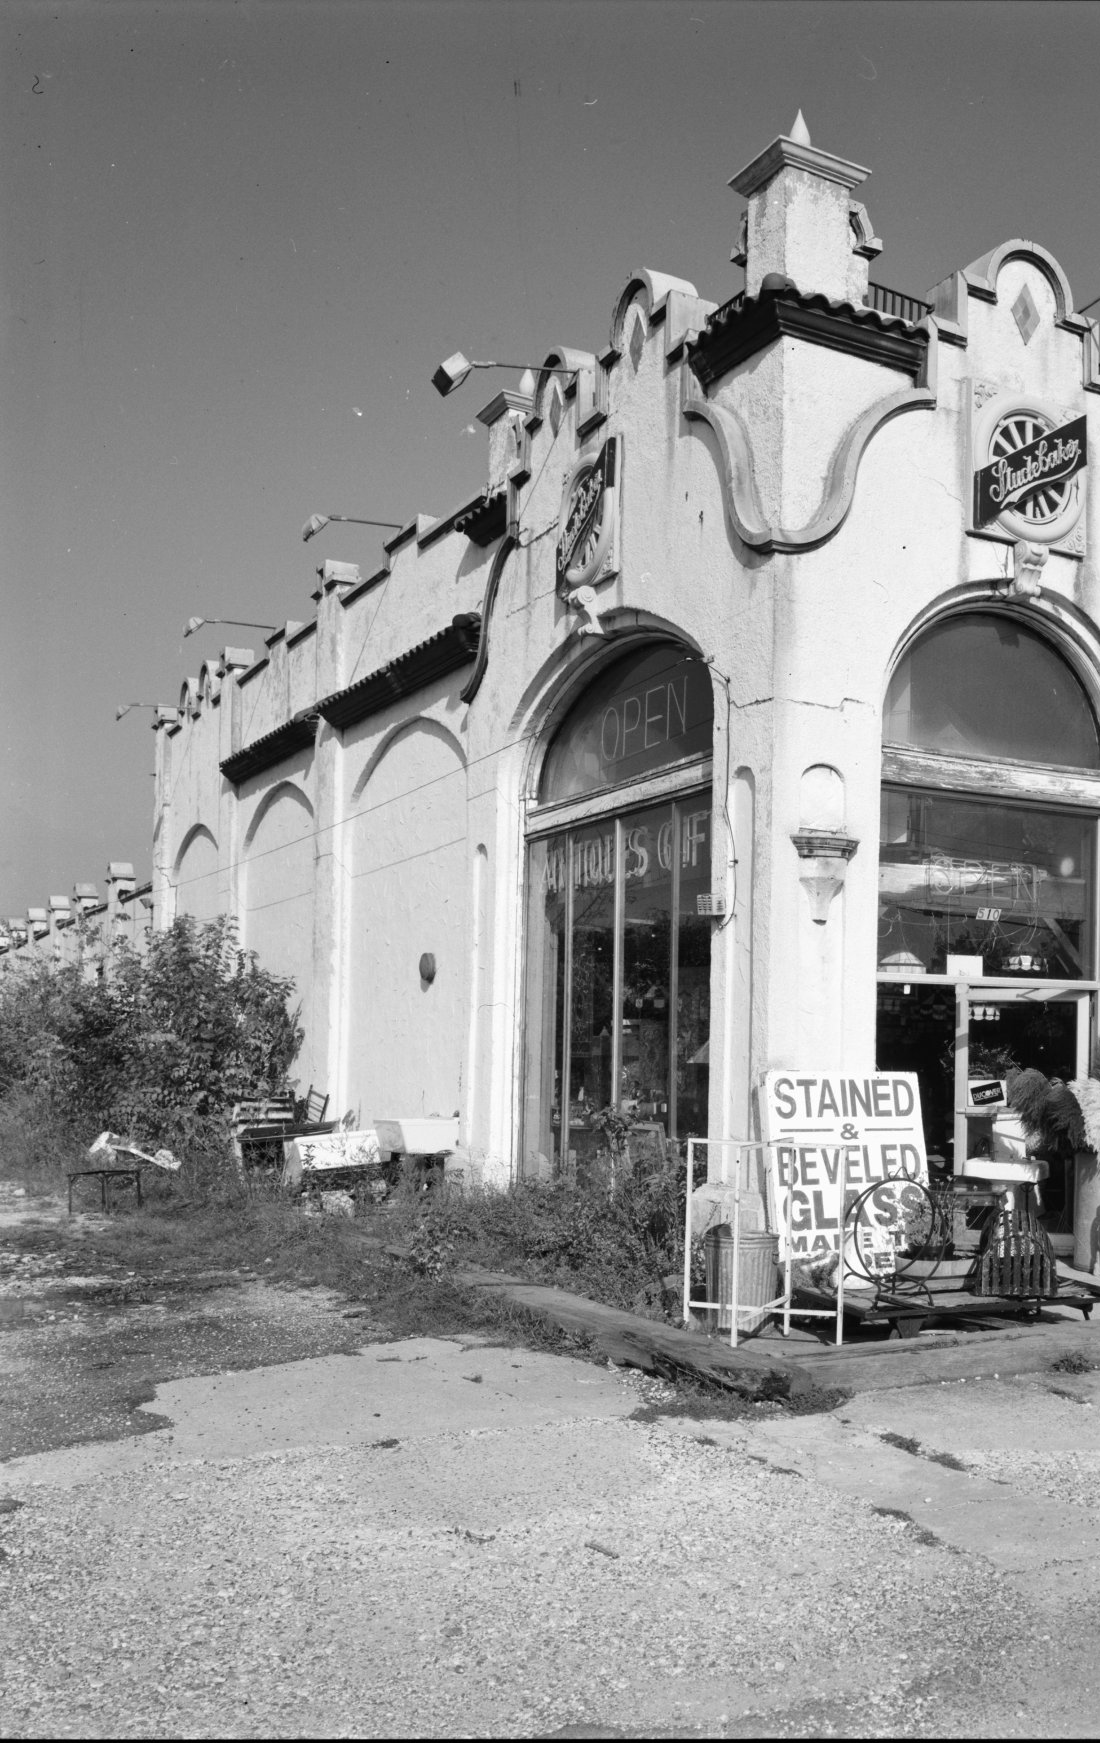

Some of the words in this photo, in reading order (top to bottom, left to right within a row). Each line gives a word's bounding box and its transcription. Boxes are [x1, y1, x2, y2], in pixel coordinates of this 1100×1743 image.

[989, 438, 1082, 503] Studebaker
[601, 675, 689, 761] OPEN
[932, 856, 1038, 904] OPEN
[976, 908, 1000, 921] 510
[774, 1077, 915, 1119] STAINED
[840, 1122, 859, 1140] &
[776, 1143, 922, 1187] BEVELED
[782, 1185, 924, 1232] GLASS
